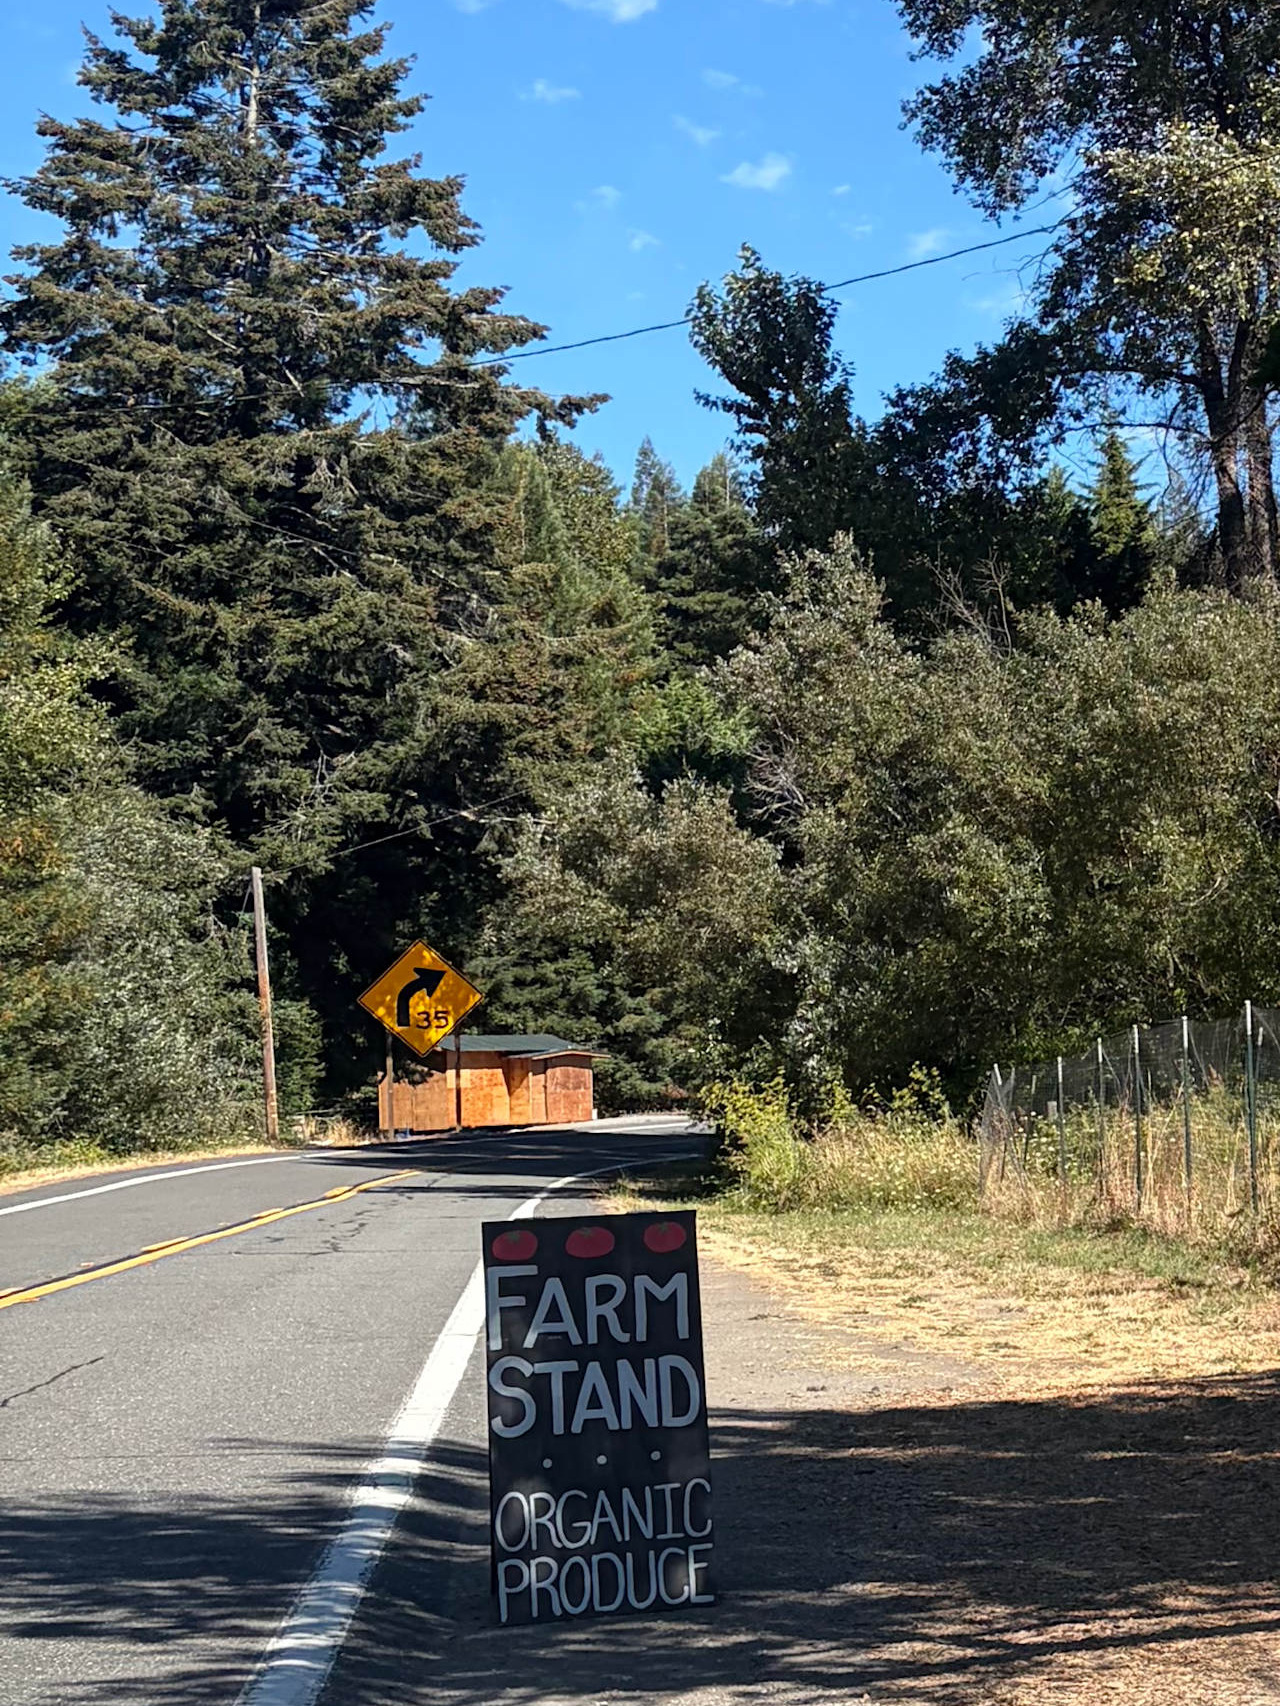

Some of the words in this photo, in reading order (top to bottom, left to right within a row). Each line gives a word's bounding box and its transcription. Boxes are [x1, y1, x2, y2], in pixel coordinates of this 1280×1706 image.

[415, 1010, 449, 1030] 35
[487, 1264, 690, 1351] FARM
[488, 1354, 701, 1439] STAND
[494, 1477, 713, 1553] ORGANIC
[497, 1543, 715, 1623] PRODUCE
